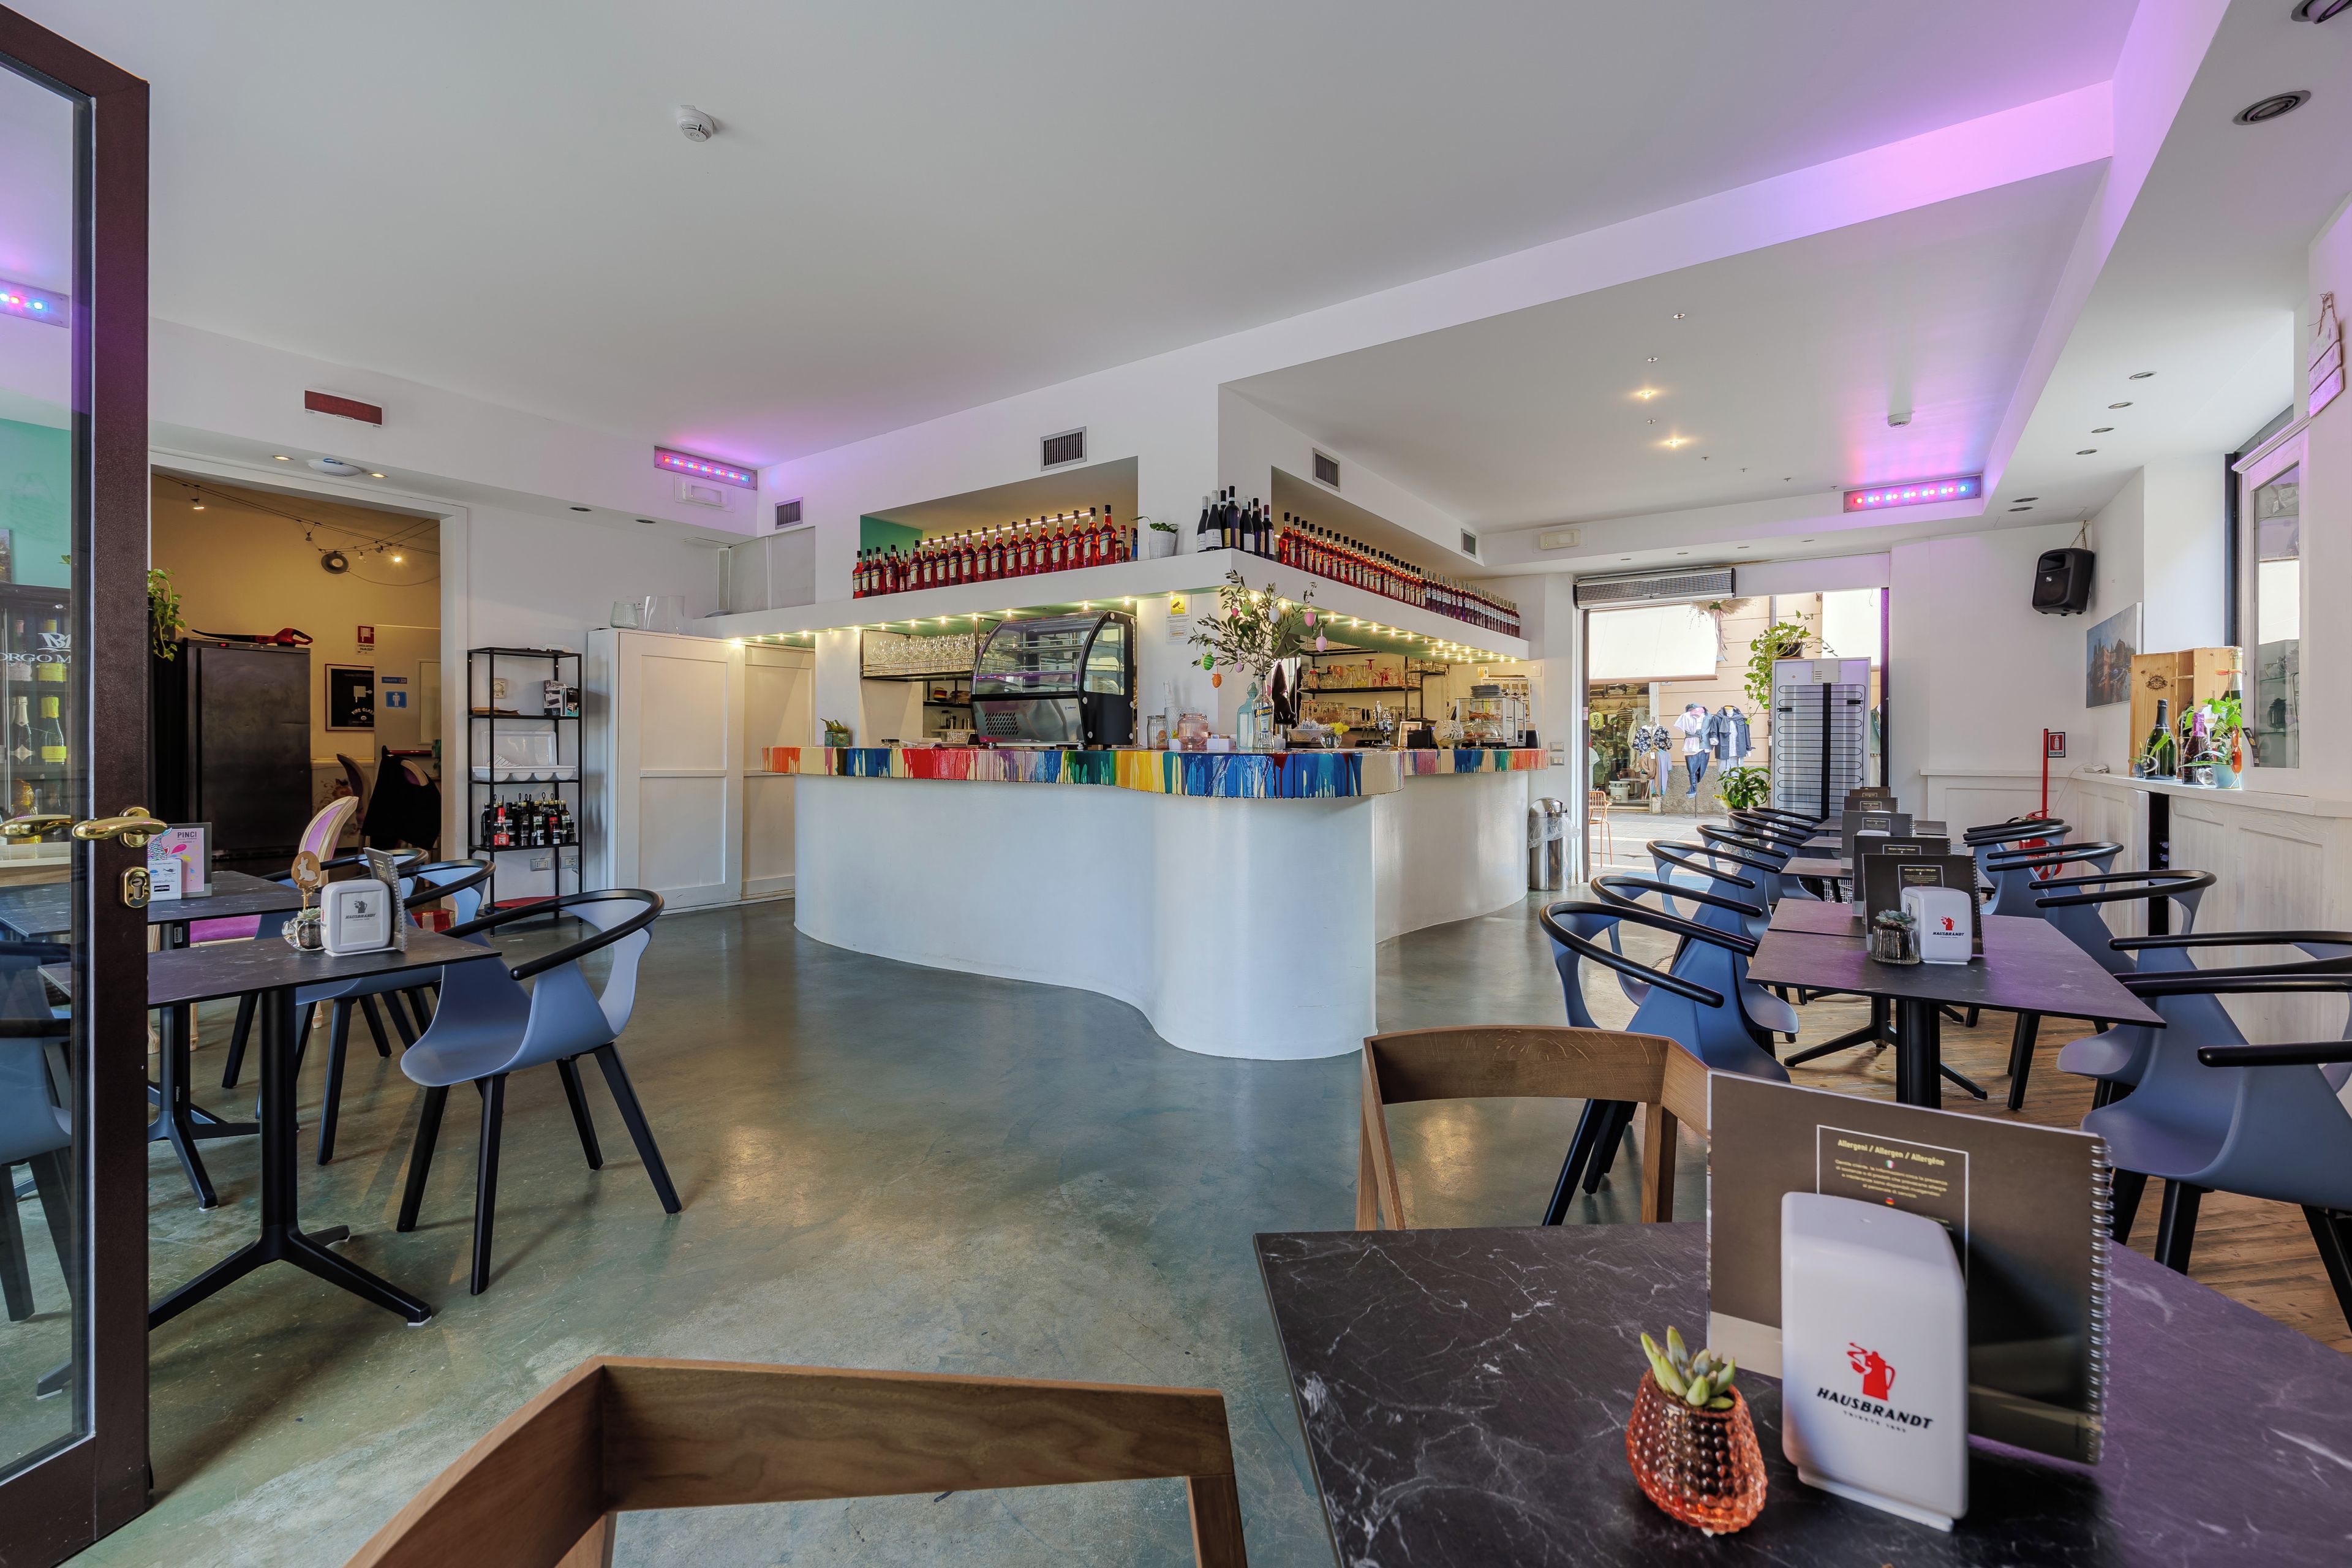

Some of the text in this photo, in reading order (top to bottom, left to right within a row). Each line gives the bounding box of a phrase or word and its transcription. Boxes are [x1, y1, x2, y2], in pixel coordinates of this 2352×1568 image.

[1838, 1139, 1868, 1152] Allergeni
[1874, 1147, 1904, 1159] Allergen
[1817, 1387, 1934, 1429] HAUSBRANDT
